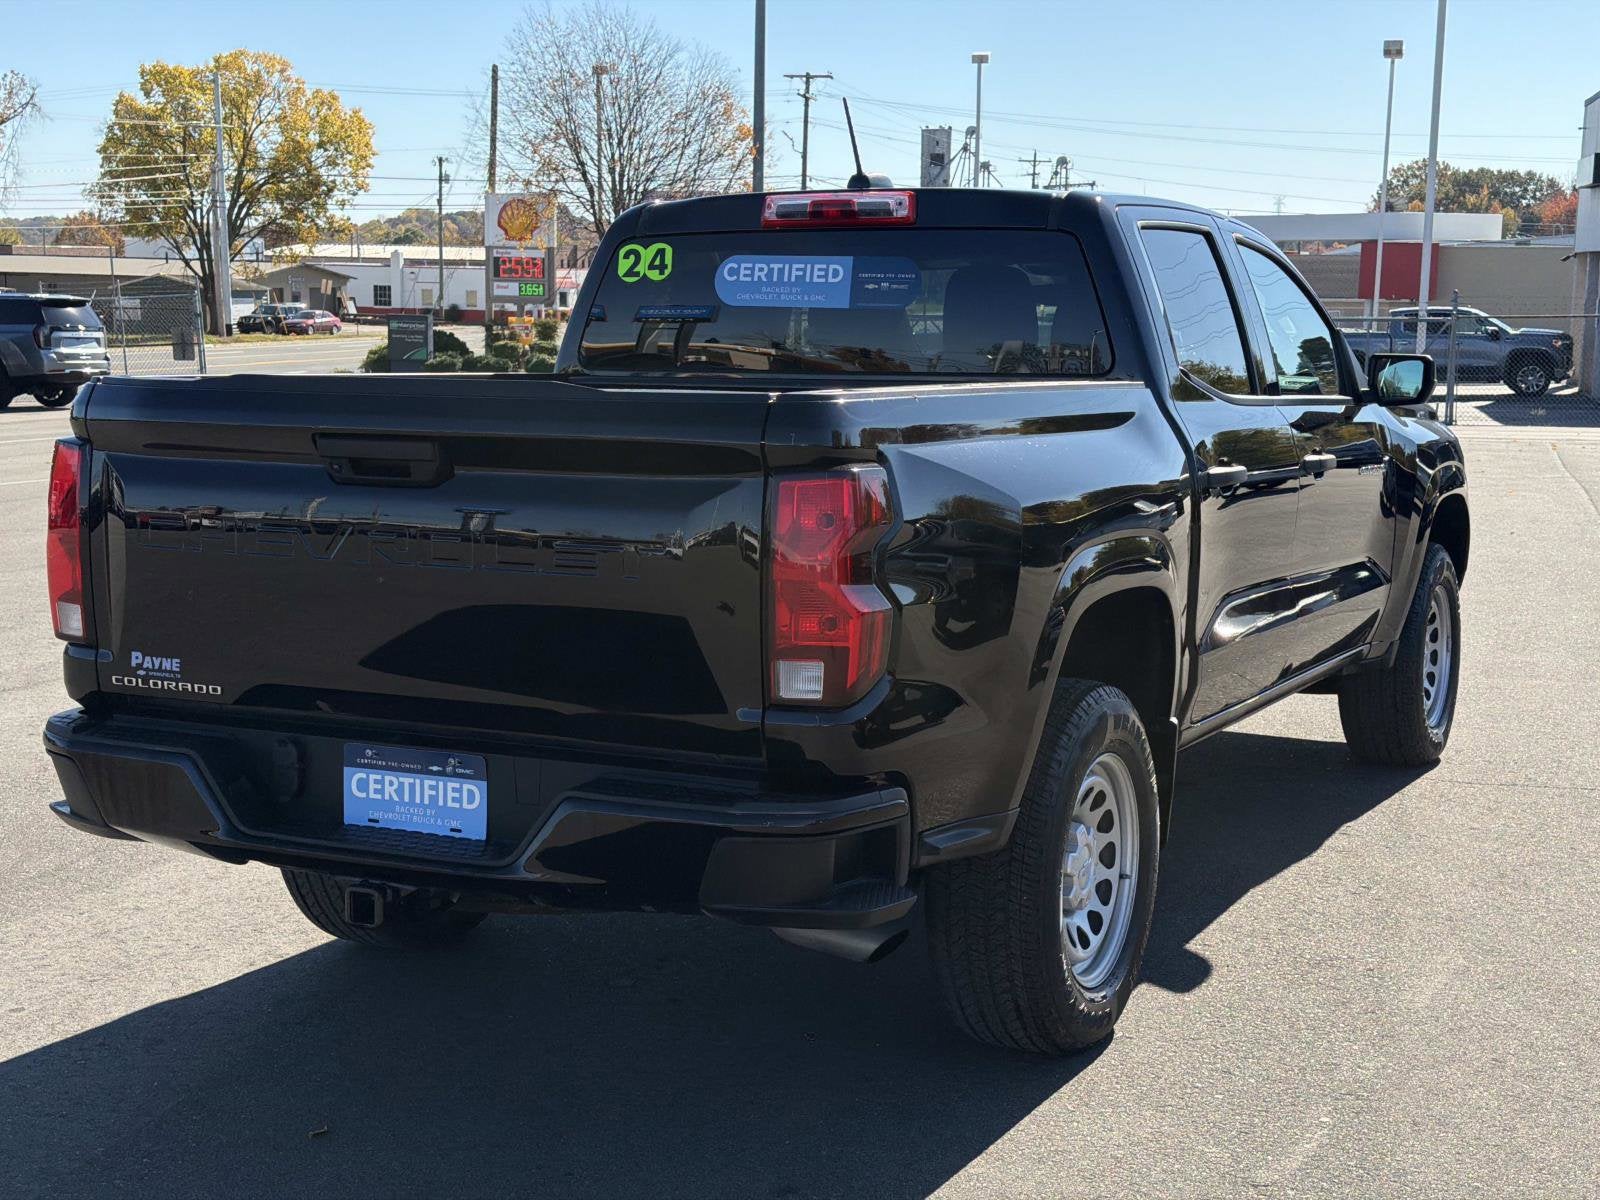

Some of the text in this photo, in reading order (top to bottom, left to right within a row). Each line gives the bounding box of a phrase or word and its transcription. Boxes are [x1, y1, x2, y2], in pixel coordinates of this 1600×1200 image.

[622, 248, 668, 277] 24
[723, 262, 844, 283] CERTIFIED
[780, 293, 801, 301] BUICK
[111, 675, 222, 695] COLORADO
[351, 772, 480, 810] CERTIFIED
[395, 805, 437, 817] BACKED BY
[412, 815, 436, 825] BUICK
[444, 819, 463, 829] GMC
